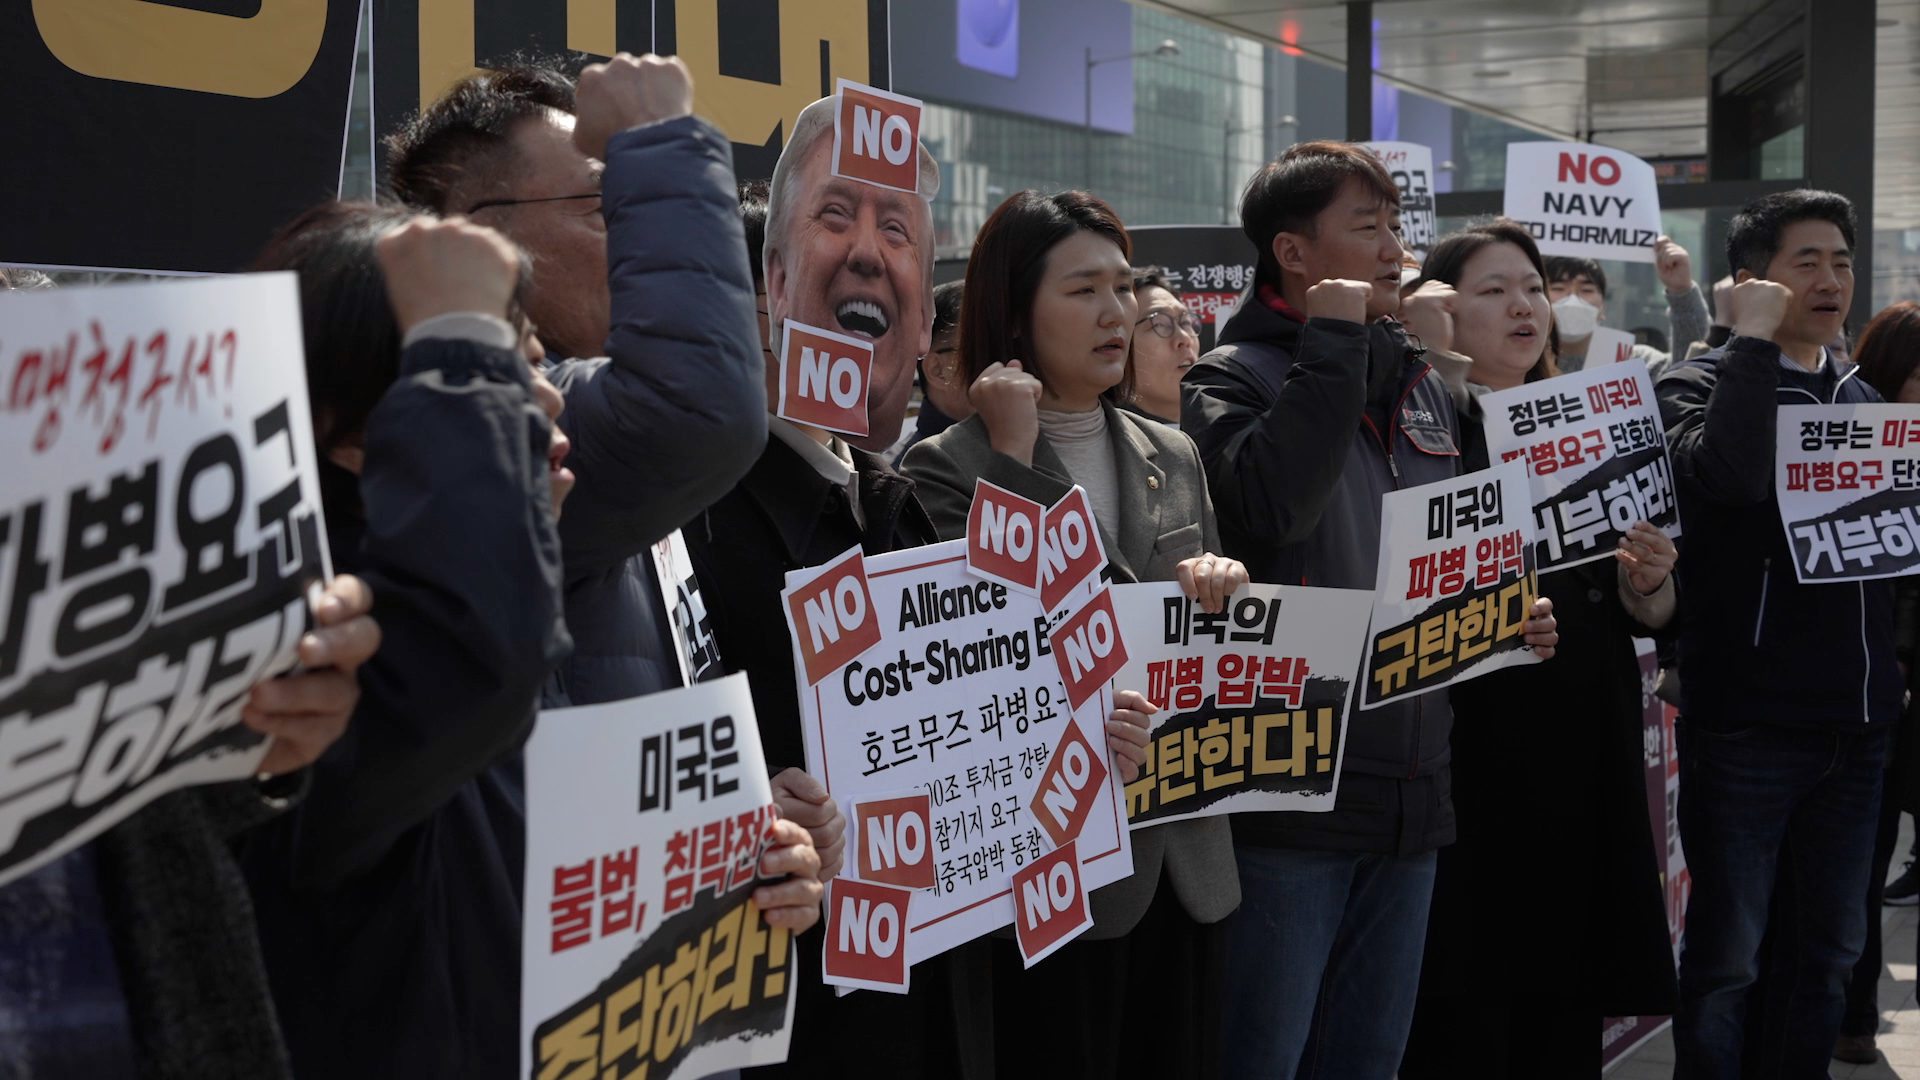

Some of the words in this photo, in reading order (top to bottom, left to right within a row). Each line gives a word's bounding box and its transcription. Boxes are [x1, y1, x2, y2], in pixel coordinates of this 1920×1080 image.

[853, 105, 912, 165] NO
[1558, 152, 1621, 186] NO
[1543, 192, 1633, 218] NAVY
[1180, 294, 1240, 319] 단하
[0, 317, 237, 456] 맹청구서?
[798, 346, 861, 408] NO
[1508, 393, 1585, 437] 정부는
[1586, 376, 1643, 415] 미국의
[1608, 415, 1662, 456] 단호히
[1800, 420, 1873, 451] 정부는
[1786, 459, 1884, 492] 파병요구
[1892, 459, 1920, 488] 단
[980, 500, 1033, 562] NO
[1427, 479, 1503, 541] 미국의
[1793, 504, 1920, 574] 거부하
[1042, 509, 1087, 585] NO
[1406, 545, 1467, 601] 파병
[1475, 529, 1524, 586] 압박
[803, 575, 866, 654] NO
[899, 581, 1007, 632] Alliance
[1163, 596, 1282, 646] 미국의
[1374, 569, 1538, 696] 규탄한다!
[843, 629, 1030, 706] Cost-Sharing
[1063, 609, 1114, 684] NO
[1147, 656, 1203, 711] 파병
[1217, 653, 1309, 706] 압박
[861, 710, 972, 777] 호르무즈
[979, 684, 1068, 742] 파병요
[637, 714, 740, 814] 미국은
[966, 756, 1013, 798] 투자금
[1043, 740, 1090, 832] NO
[867, 811, 926, 871] NO
[935, 805, 984, 852] 참기지
[991, 795, 1021, 829] 요구
[1011, 826, 1041, 867] 동참
[551, 846, 648, 954] 불법,
[839, 896, 899, 958] NO
[1023, 861, 1075, 931] NO
